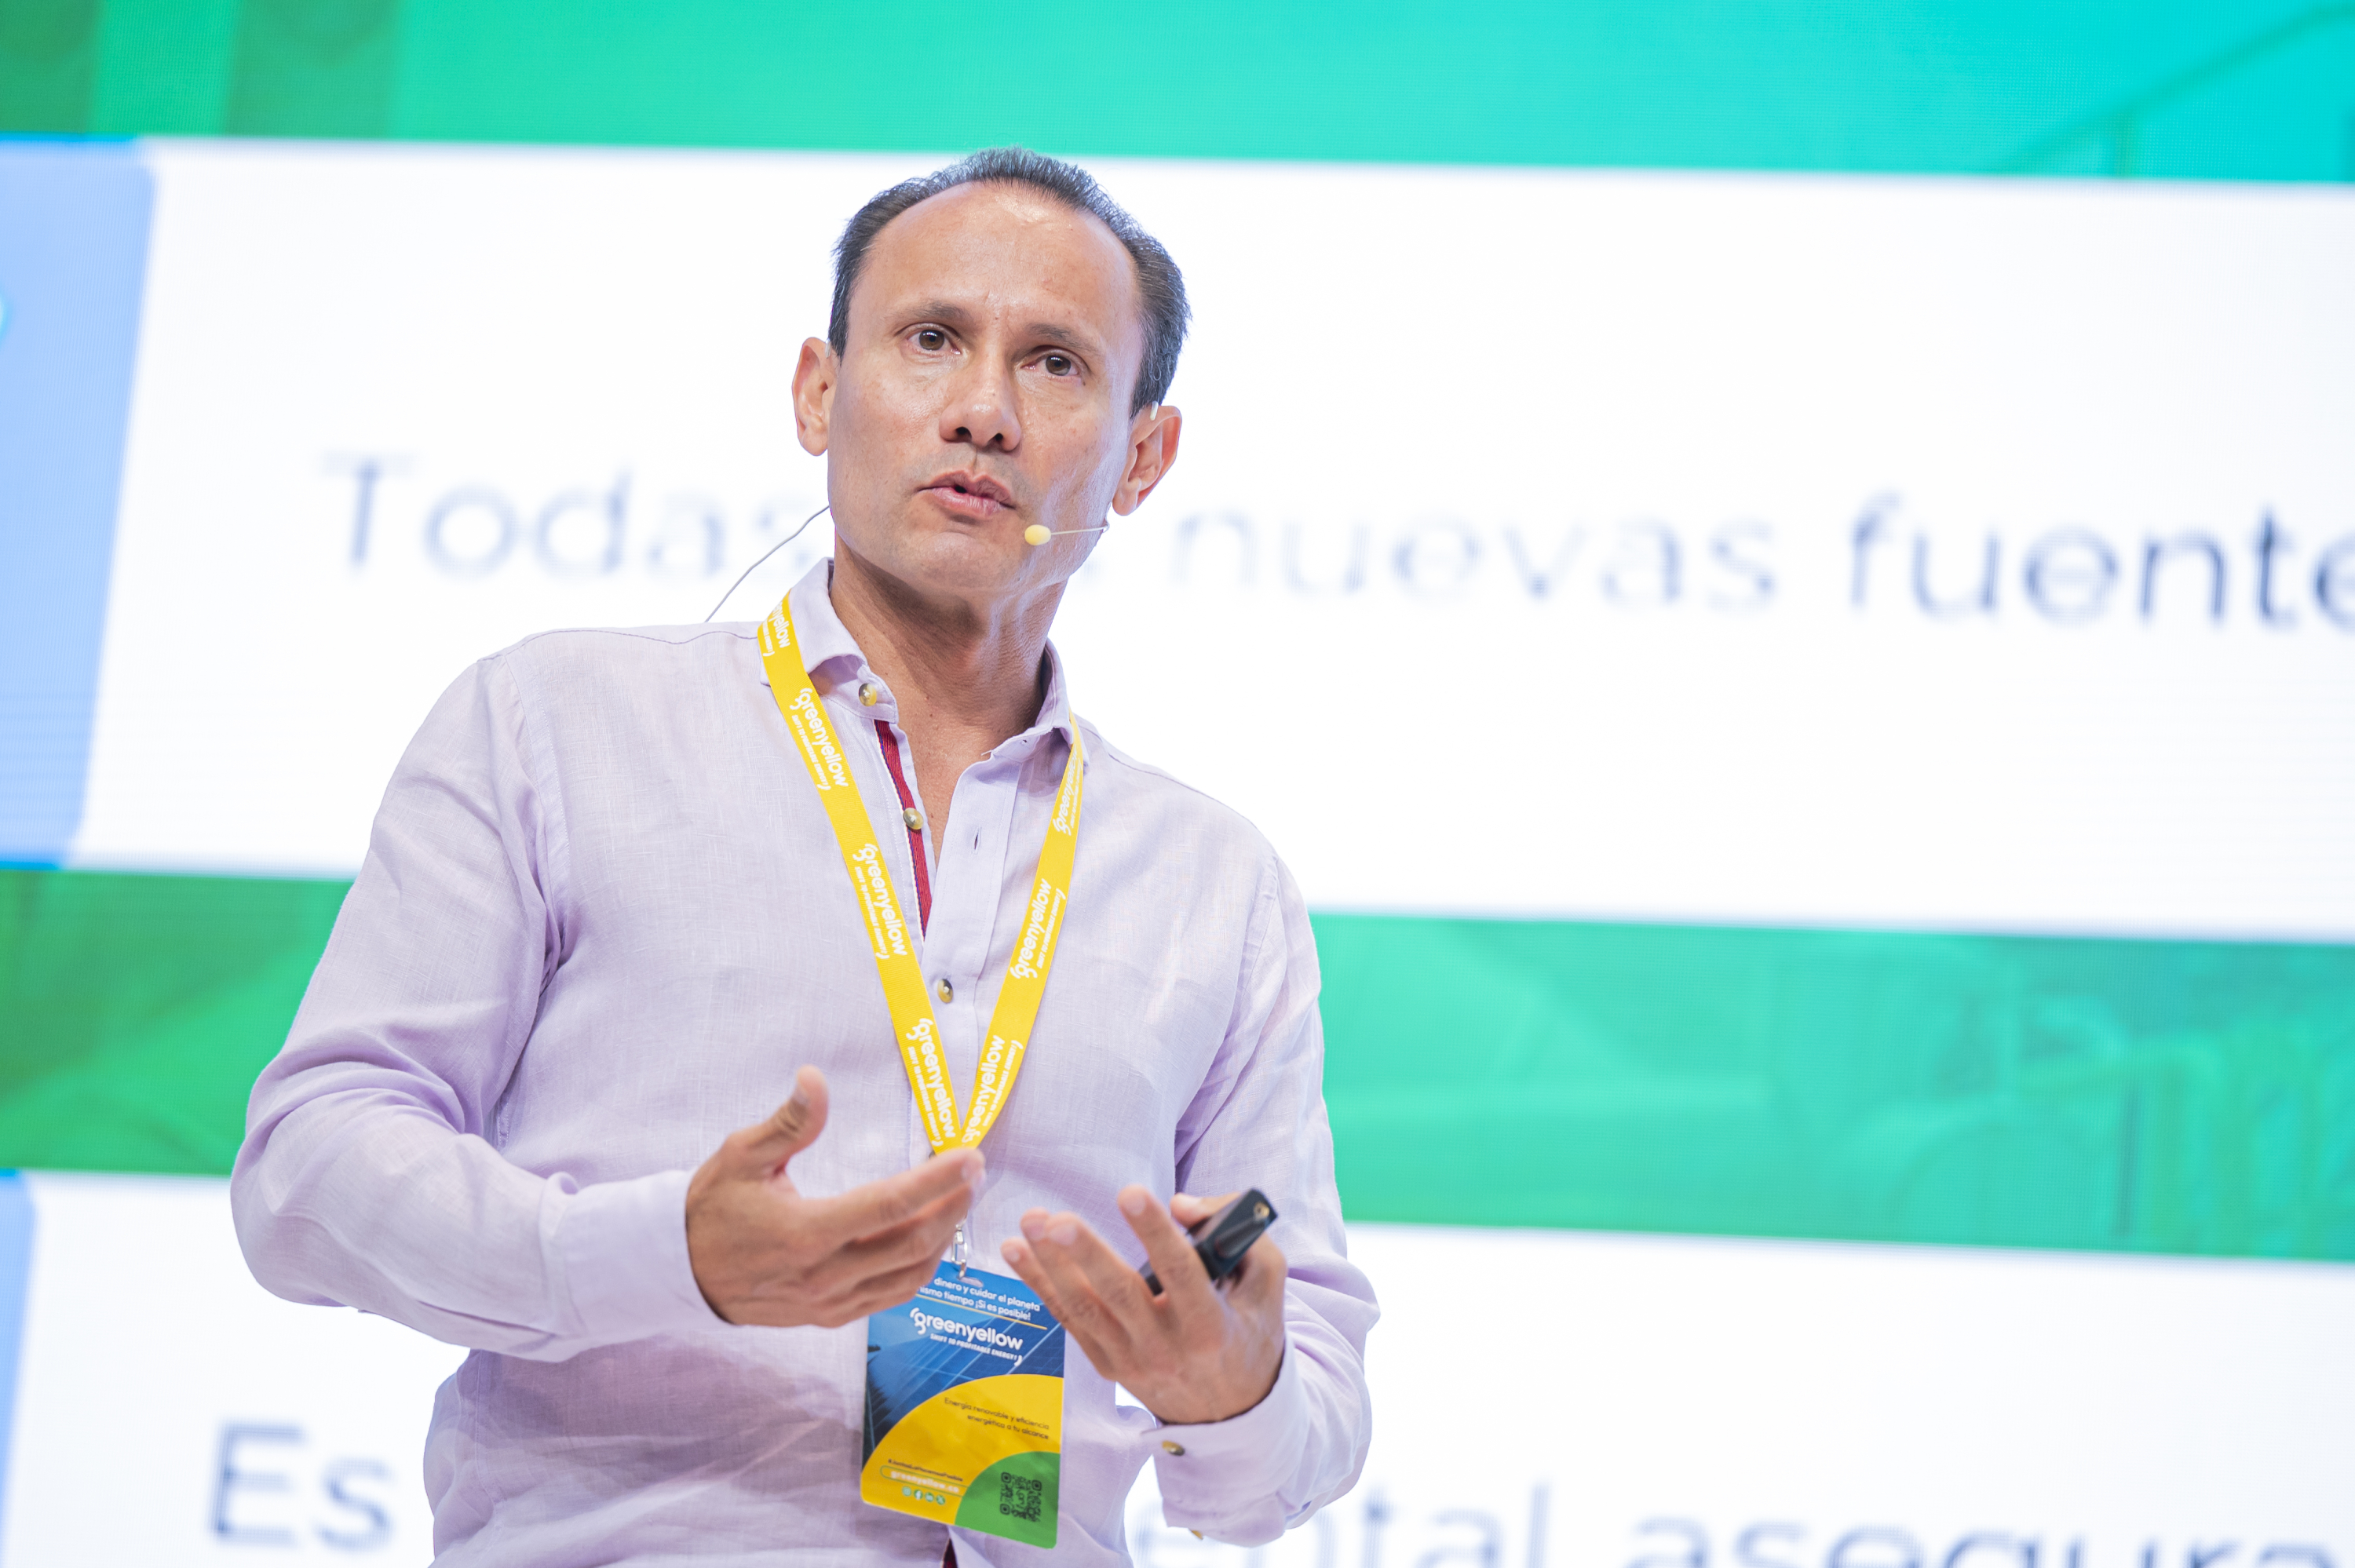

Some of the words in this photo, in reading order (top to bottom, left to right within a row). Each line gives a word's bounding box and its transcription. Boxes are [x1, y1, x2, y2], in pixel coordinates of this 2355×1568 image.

[322, 451, 819, 582] Todas
[1168, 509, 1778, 612] nuevas
[790, 689, 848, 786] greenyellow
[1053, 744, 1077, 834] greenyellow
[853, 844, 907, 954] greenyellow
[1010, 877, 1051, 979] greenyellow
[906, 1019, 955, 1136] greenyellow
[962, 1034, 1004, 1143] greenyellow
[910, 1307, 1023, 1350] greenyellow
[929, 1333, 947, 1343] SHIFT
[955, 1339, 991, 1354] PROFITABLE
[933, 1276, 962, 1291] dinero
[969, 1285, 997, 1300] cuidar
[998, 1293, 1006, 1302] el
[1006, 1296, 1041, 1312] planeta
[943, 1291, 974, 1307] tiempo
[986, 1303, 998, 1311] es
[997, 1305, 1031, 1322] posible!
[210, 1419, 395, 1551] Es
